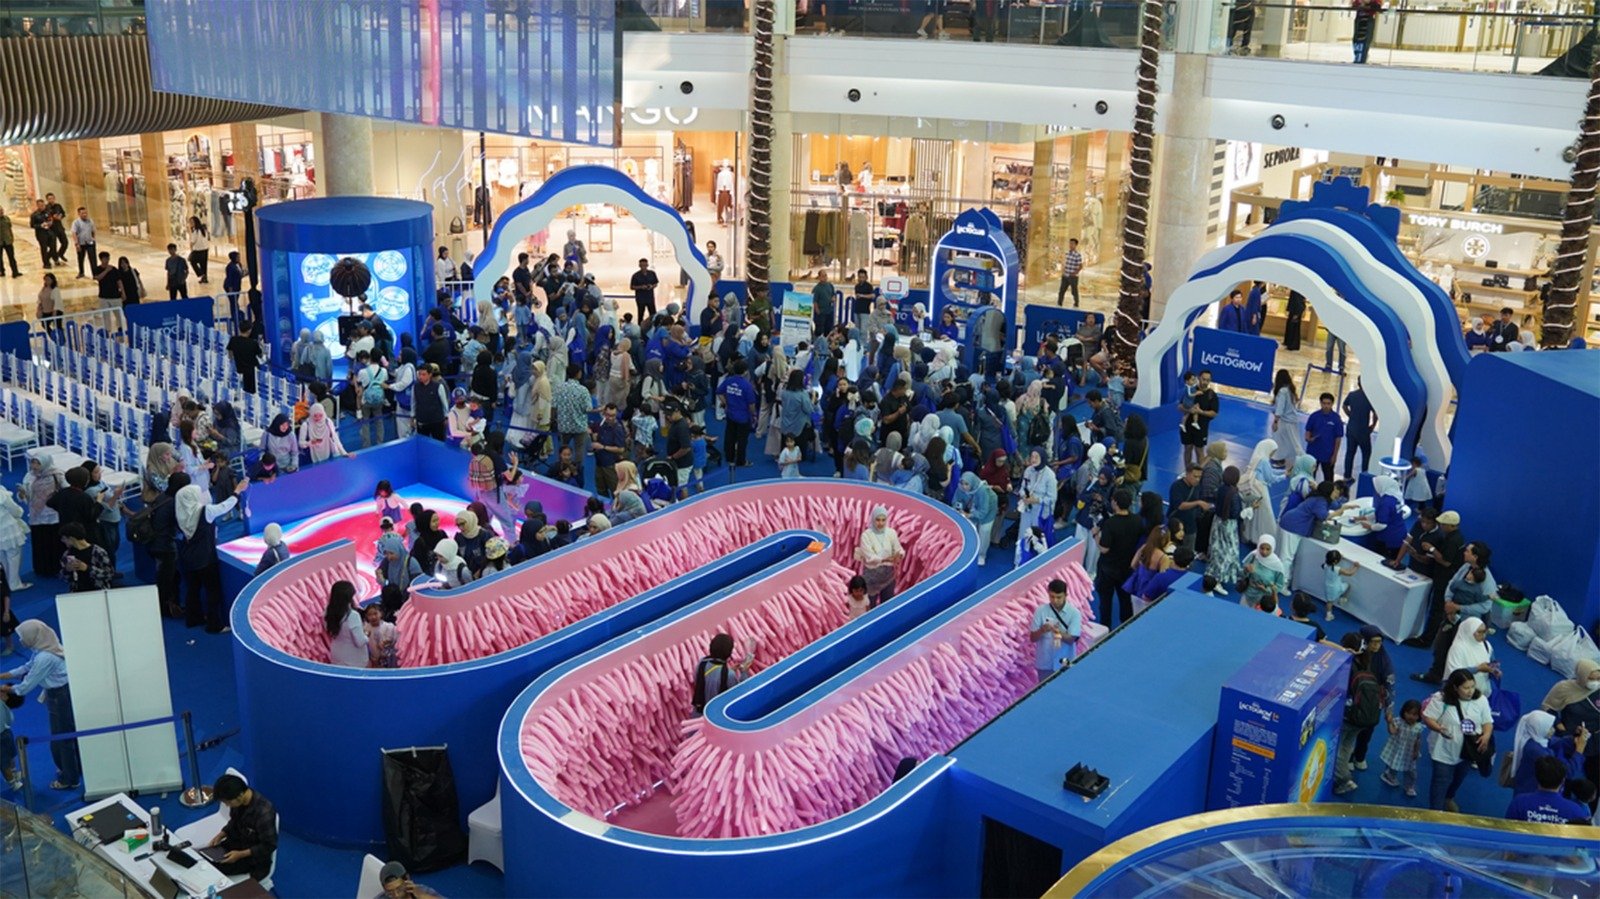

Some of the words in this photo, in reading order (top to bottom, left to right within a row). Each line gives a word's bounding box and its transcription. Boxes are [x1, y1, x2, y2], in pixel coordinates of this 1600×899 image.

[1408, 213, 1448, 228] TORY
[1450, 218, 1504, 234] BURCH
[1201, 350, 1264, 372] LACTOGROW
